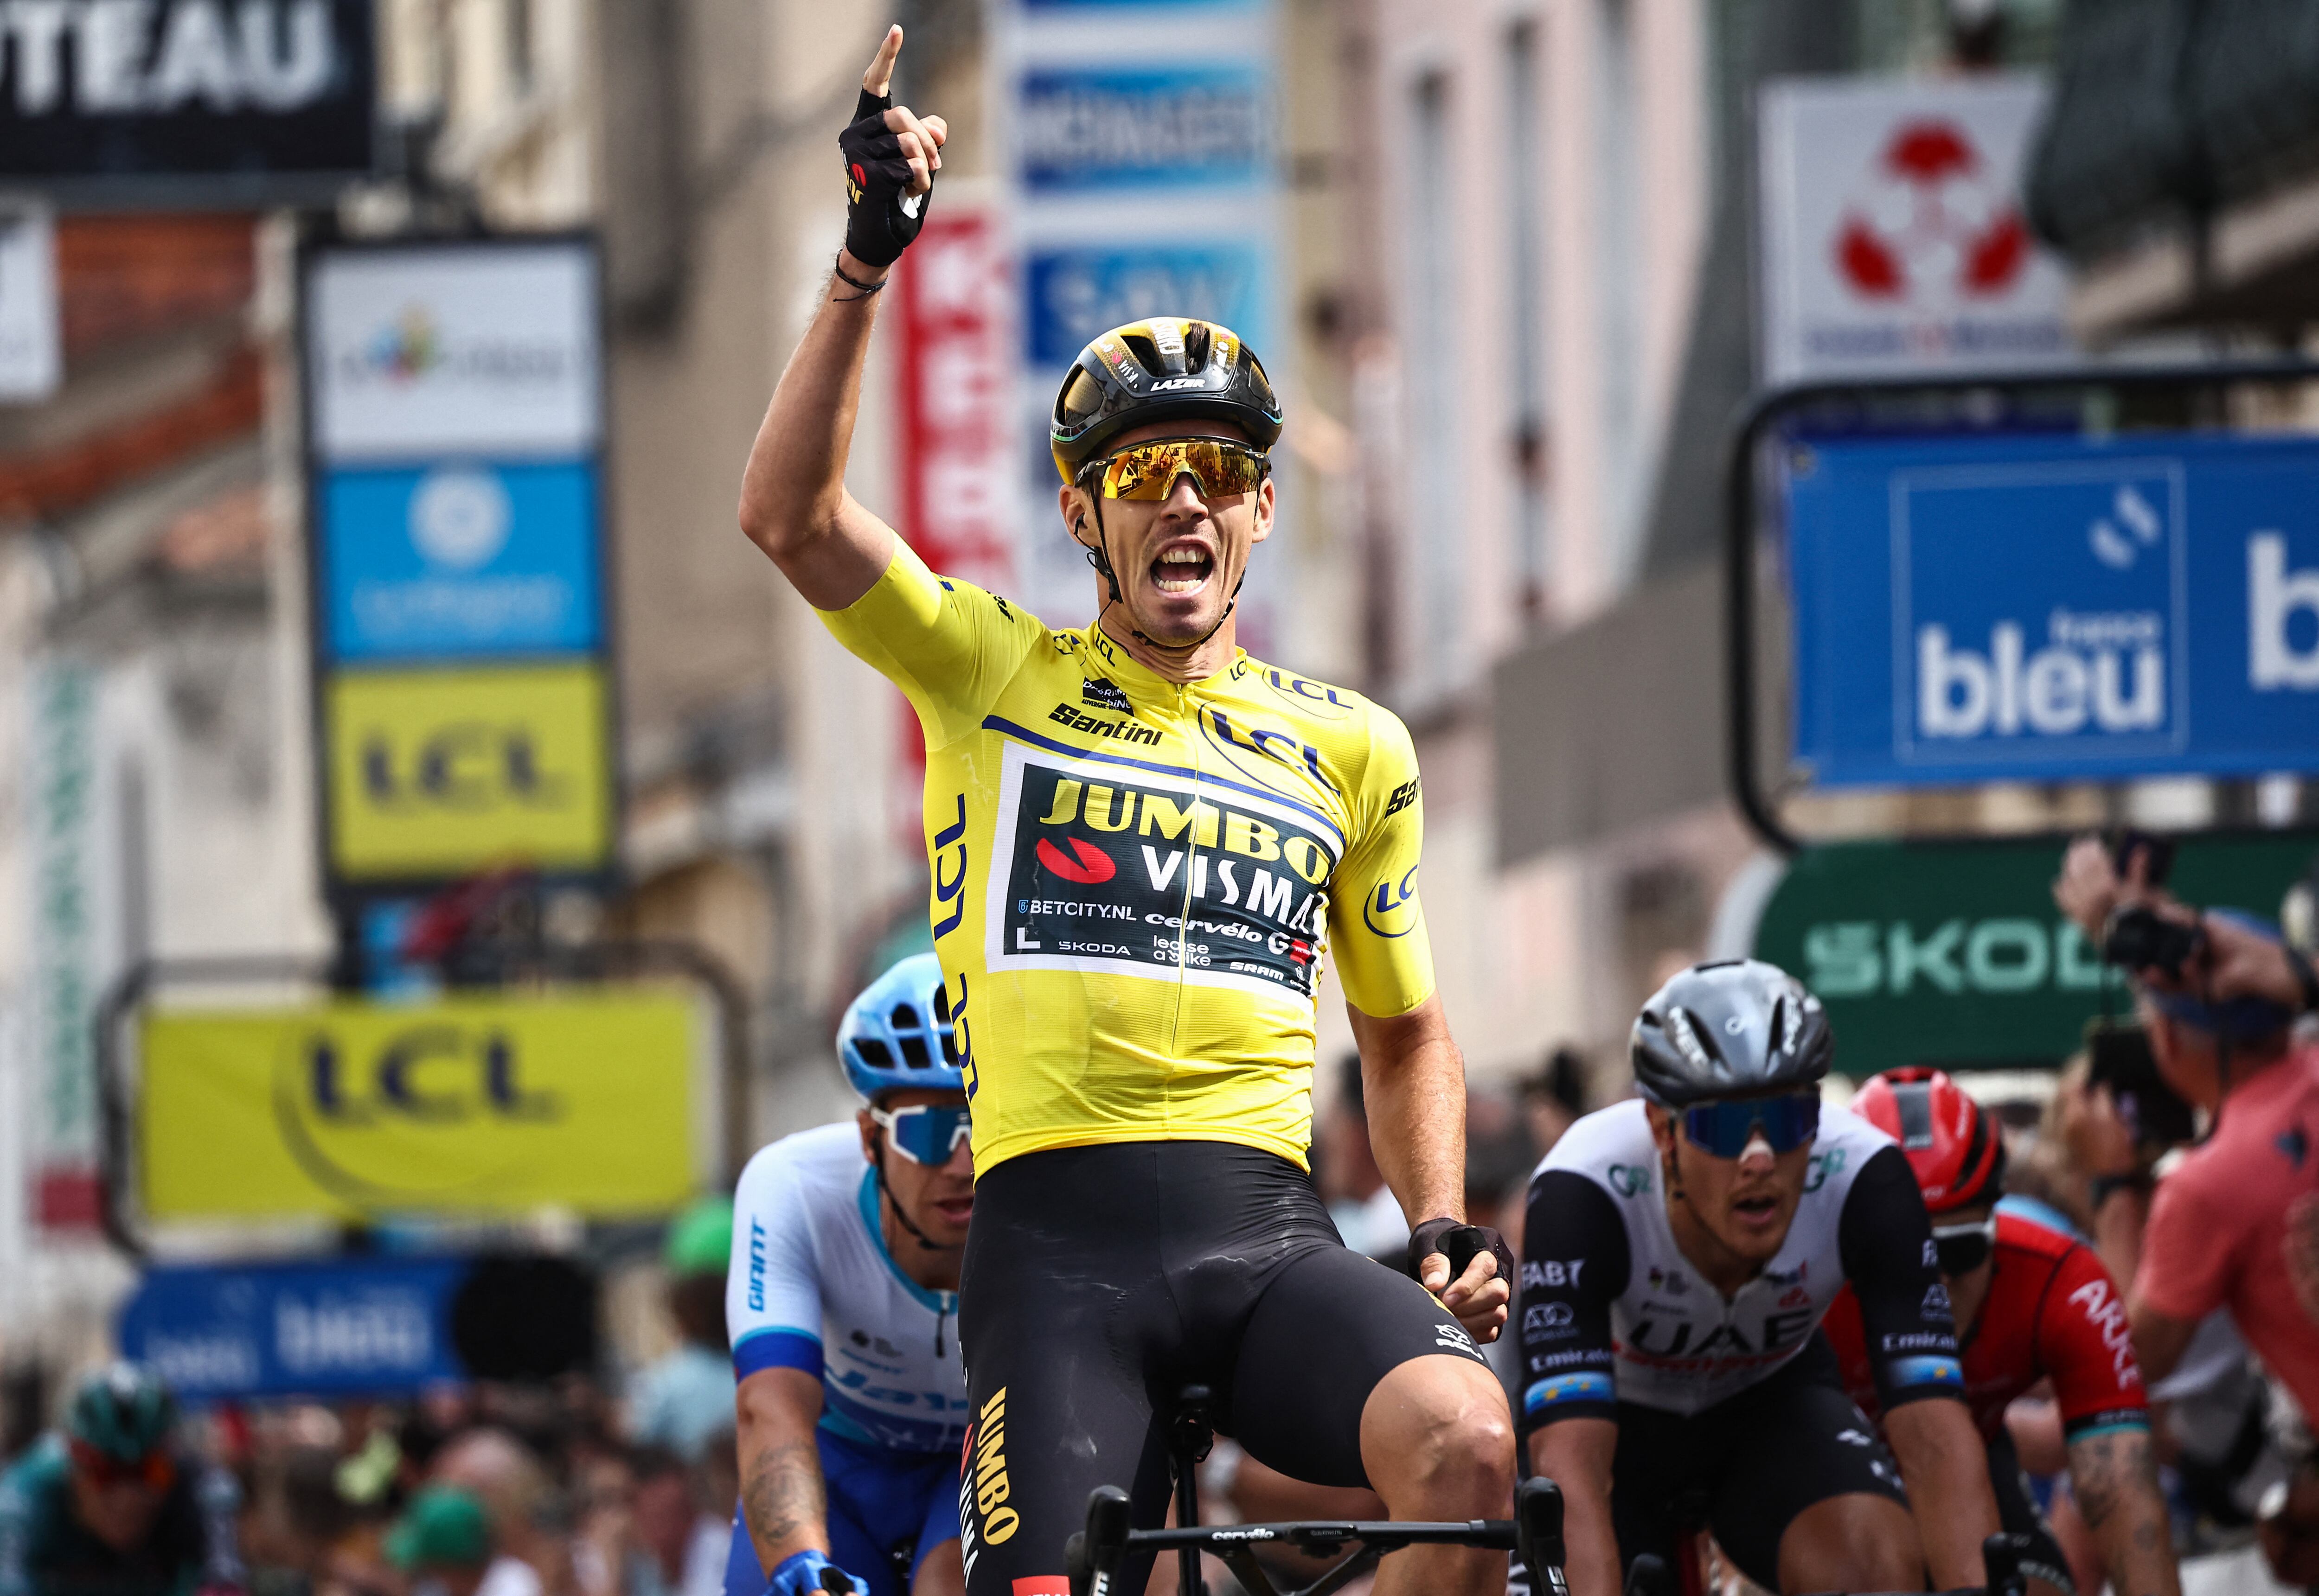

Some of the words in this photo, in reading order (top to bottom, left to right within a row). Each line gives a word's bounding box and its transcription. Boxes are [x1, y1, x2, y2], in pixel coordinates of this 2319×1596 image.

[0, 0, 327, 114] TEAU
[1150, 378, 1205, 392] LAZER
[1095, 632, 1115, 667] LCL
[1230, 659, 1247, 681] LC
[1270, 670, 1353, 709] LCL
[1916, 622, 2165, 737] bleu
[359, 723, 566, 808] LCL
[1048, 702, 1163, 746] Santini
[1210, 709, 1341, 798] LCL
[935, 793, 967, 941] LCL
[1040, 779, 1330, 885] JUMBO
[1030, 900, 1137, 921] BETCITY.NL
[1141, 845, 1312, 934] VISMA
[1144, 913, 1263, 943] cervélo
[1375, 864, 1418, 913] LC
[1229, 961, 1284, 981] SRAM
[299, 1027, 566, 1127] LCL
[952, 972, 978, 1104] LCL
[748, 1214, 767, 1313] GIANT
[1629, 1309, 1812, 1357] UAE
[976, 1386, 1019, 1545] JUMBO
